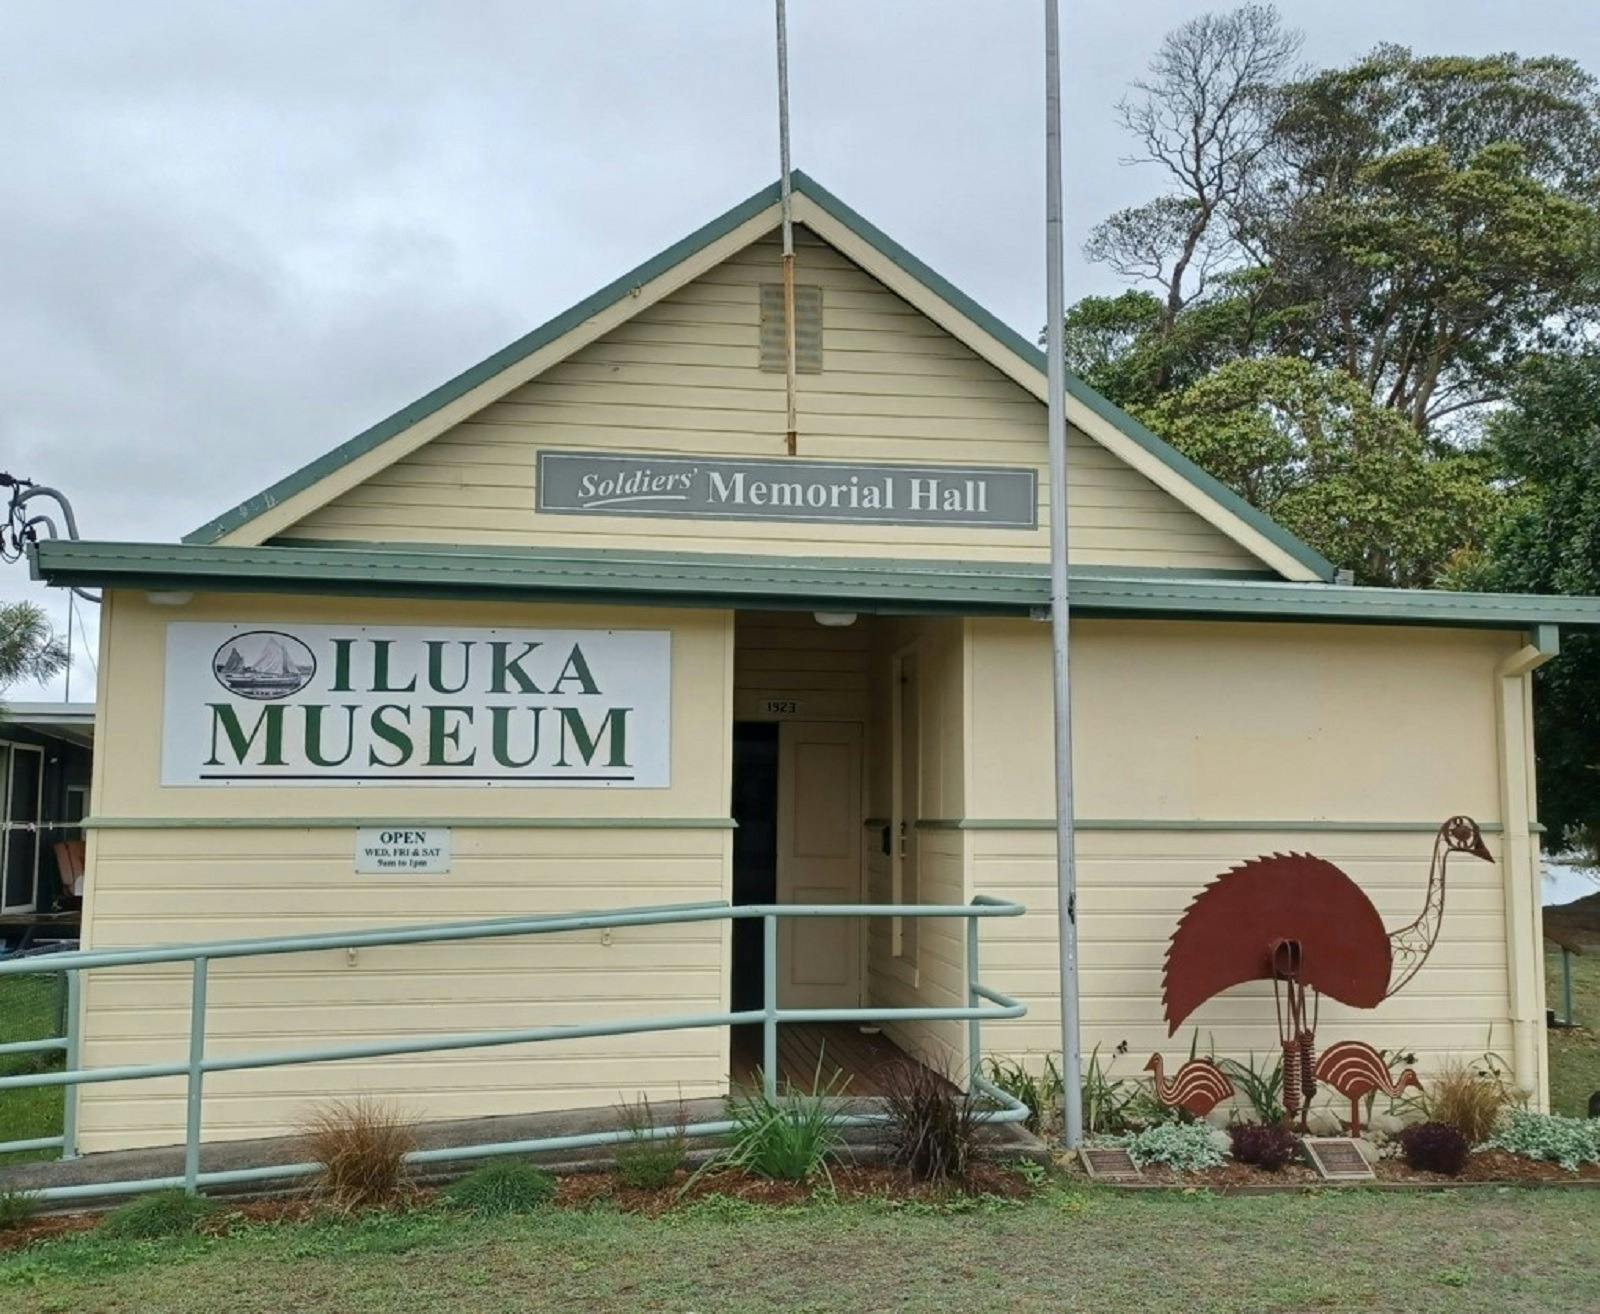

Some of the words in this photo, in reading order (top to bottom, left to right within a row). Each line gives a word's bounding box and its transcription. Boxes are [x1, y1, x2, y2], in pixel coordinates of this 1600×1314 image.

[578, 467, 699, 499] Soldiers'
[706, 471, 895, 511] Memorial
[907, 478, 989, 513] Hall
[327, 638, 603, 695] ILUKA
[767, 701, 797, 713] 1923
[203, 702, 634, 768] MUSEUM
[380, 831, 426, 844] OPEN
[393, 848, 410, 857] FRI
[412, 848, 420, 857] &
[422, 848, 440, 857] SAT
[398, 859, 407, 867] to
